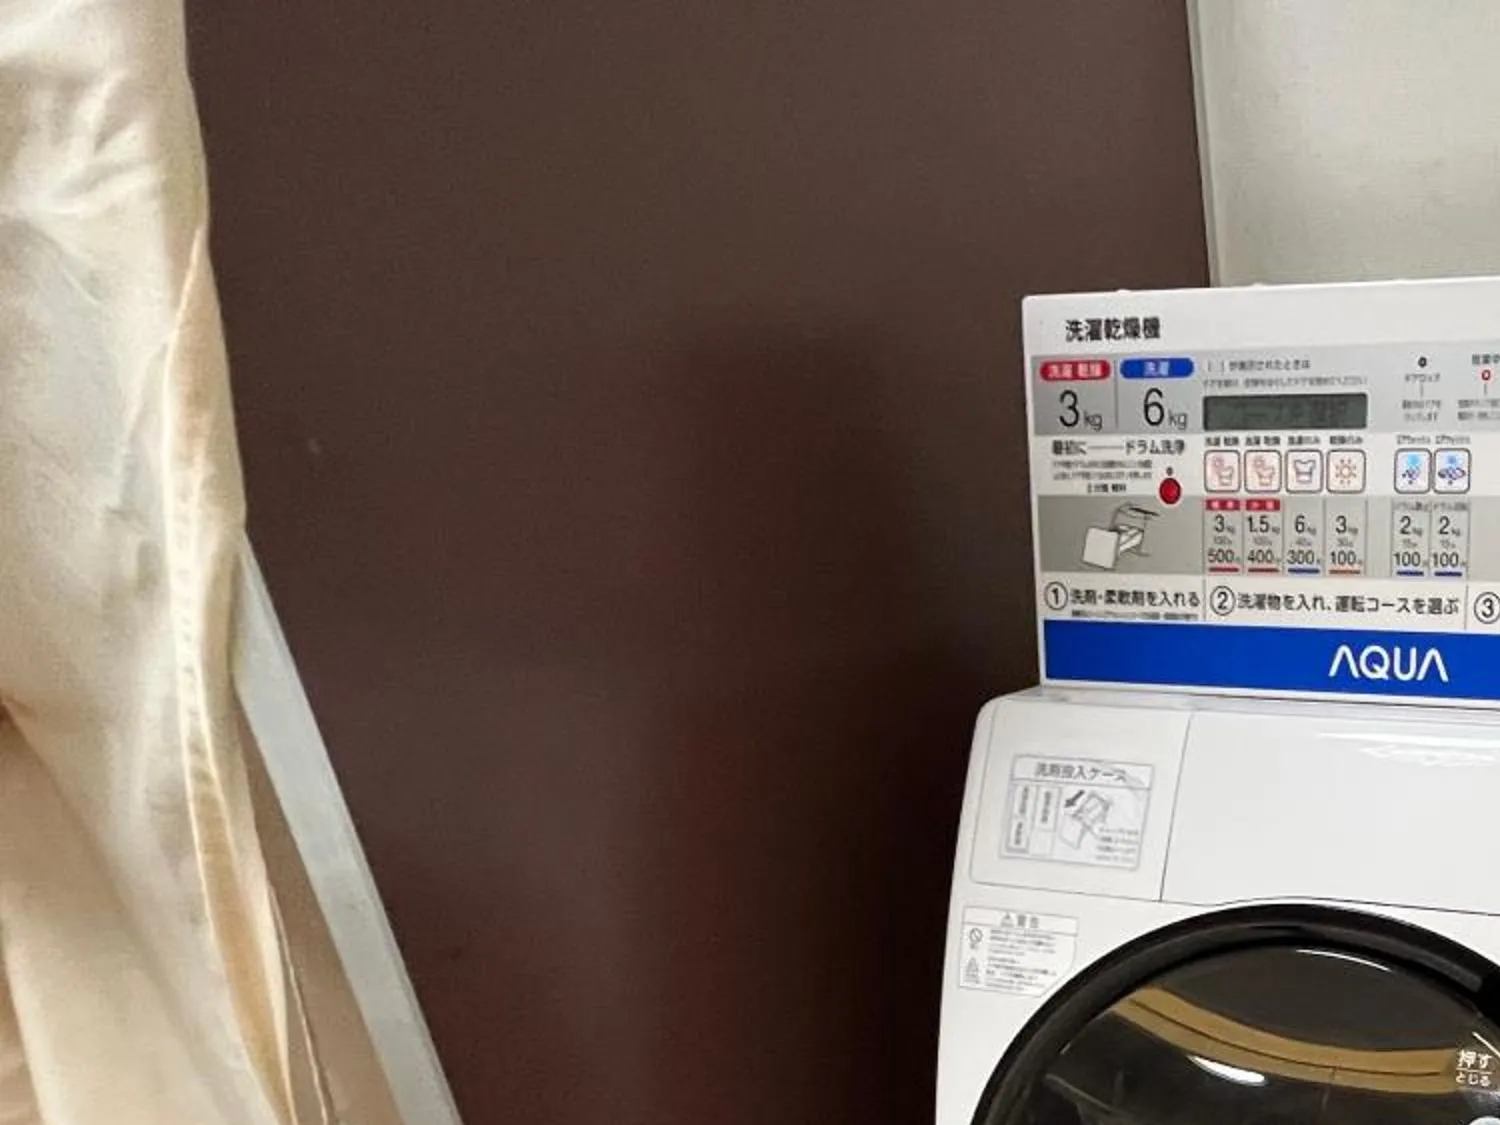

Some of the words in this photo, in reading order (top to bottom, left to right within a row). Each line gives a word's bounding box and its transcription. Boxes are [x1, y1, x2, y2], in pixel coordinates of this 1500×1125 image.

[1065, 317, 1161, 342] 洗濯乾燥機
[1328, 644, 1449, 682] AQUA
[1457, 1050, 1492, 1069] 押す
[1455, 1073, 1491, 1087] とじる
